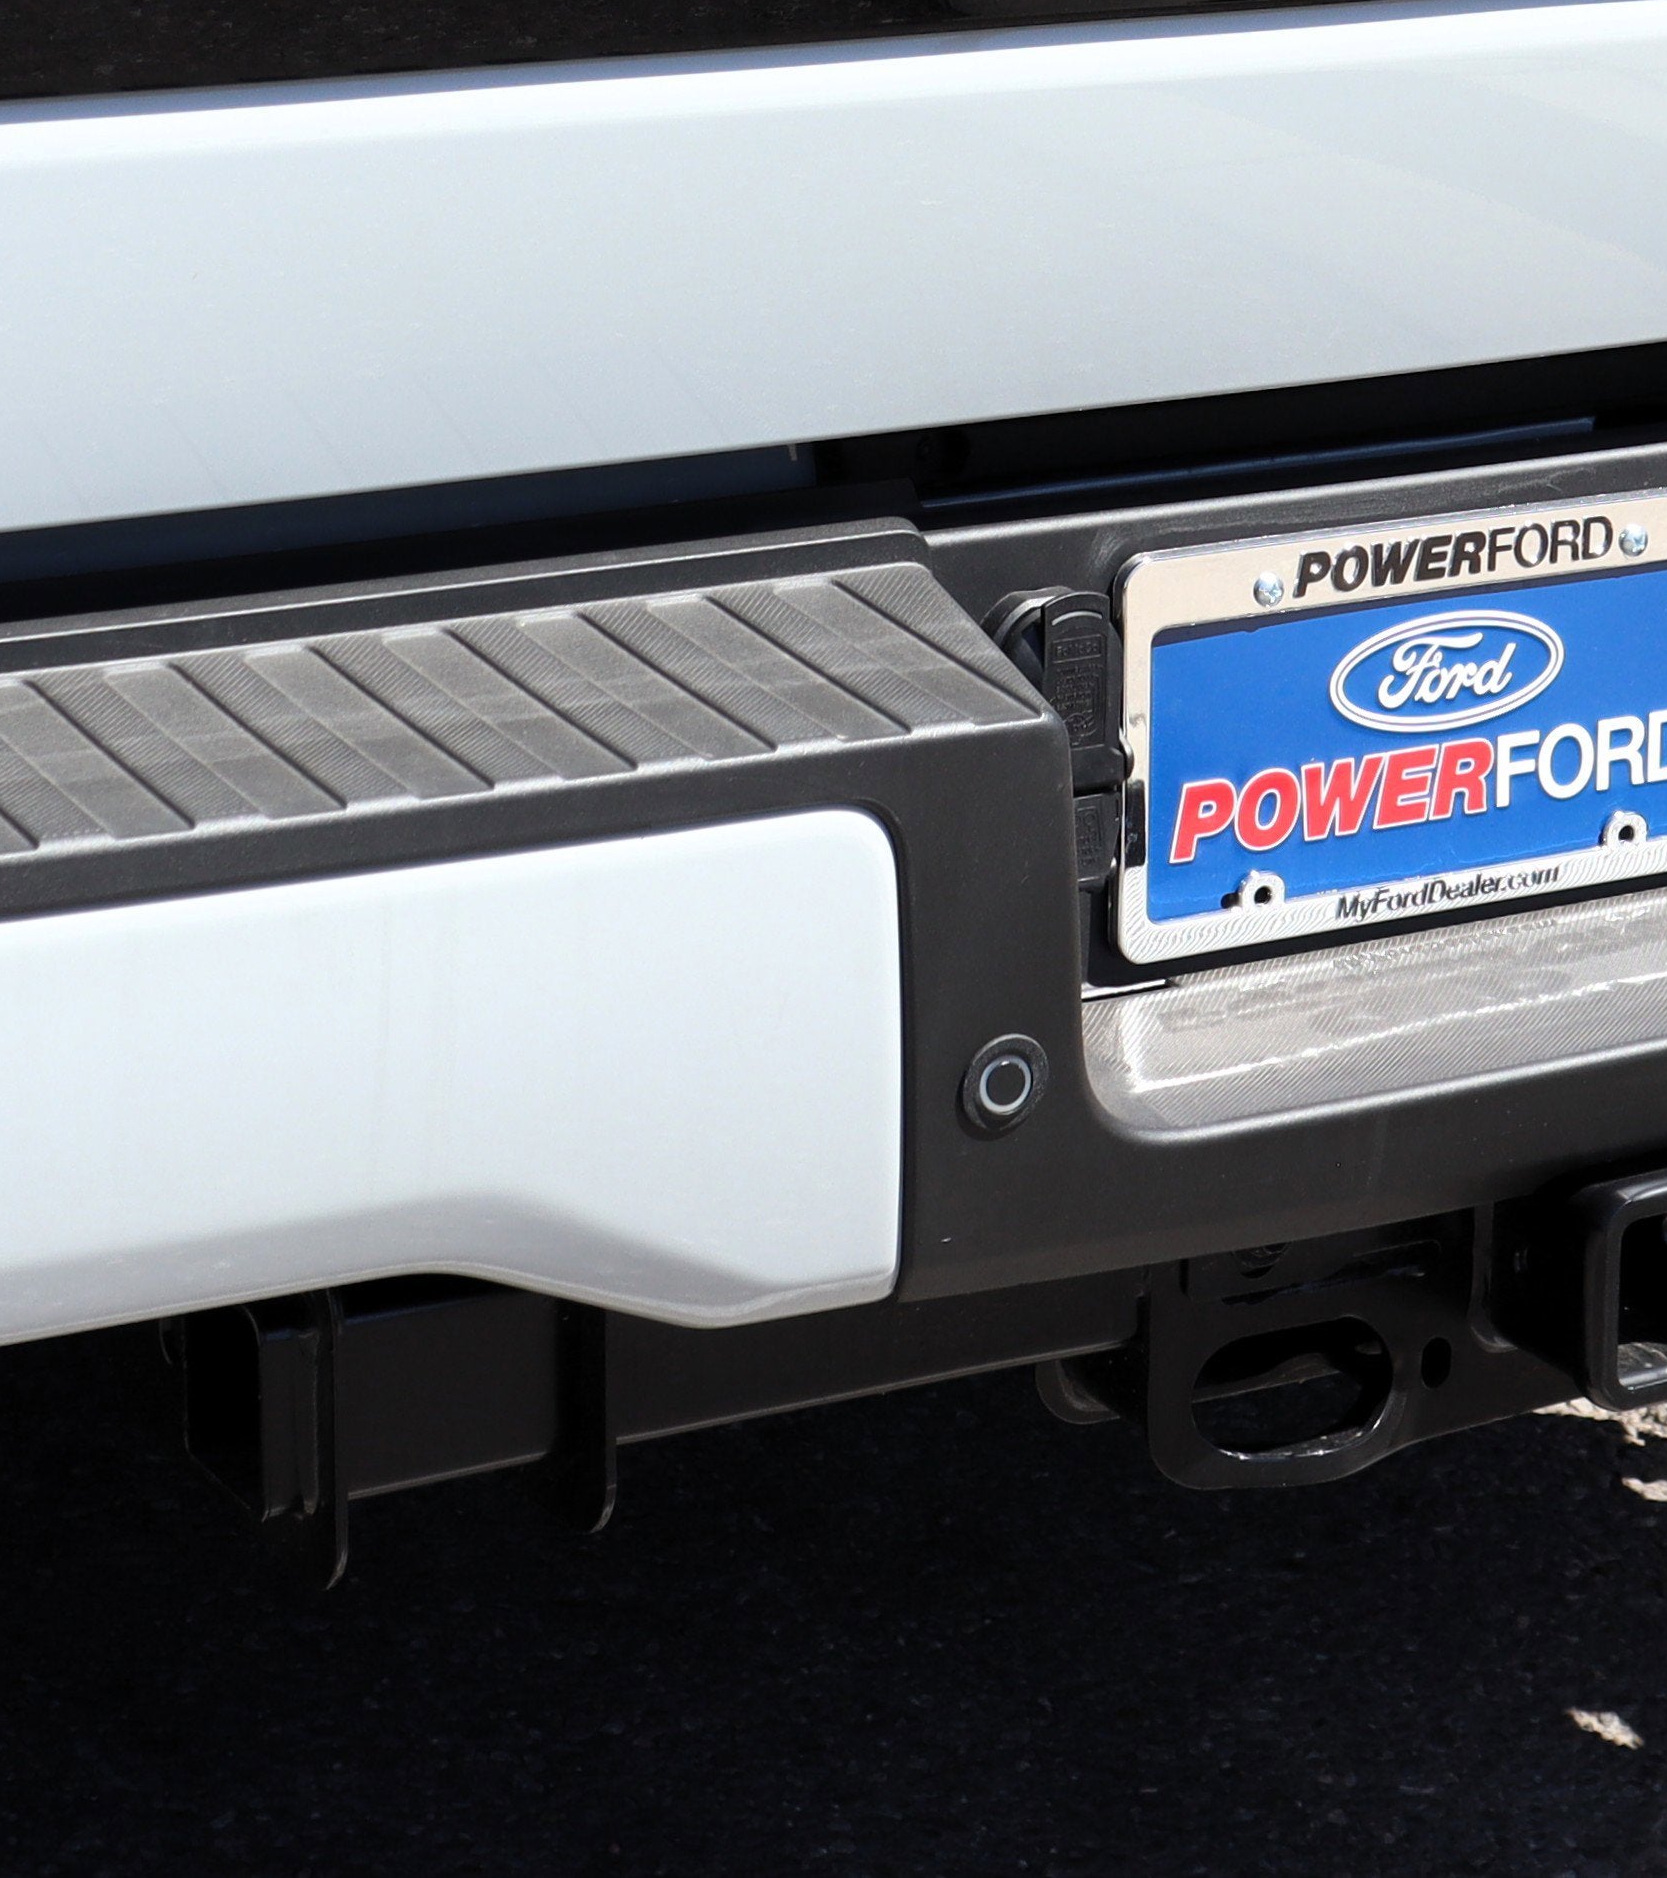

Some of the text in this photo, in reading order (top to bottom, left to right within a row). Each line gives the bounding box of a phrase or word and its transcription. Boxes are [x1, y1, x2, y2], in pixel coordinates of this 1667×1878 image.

[1292, 515, 1614, 599] POWERFORD
[1377, 631, 1517, 710] Ford
[1335, 862, 1561, 921] MyFordDealer.com
